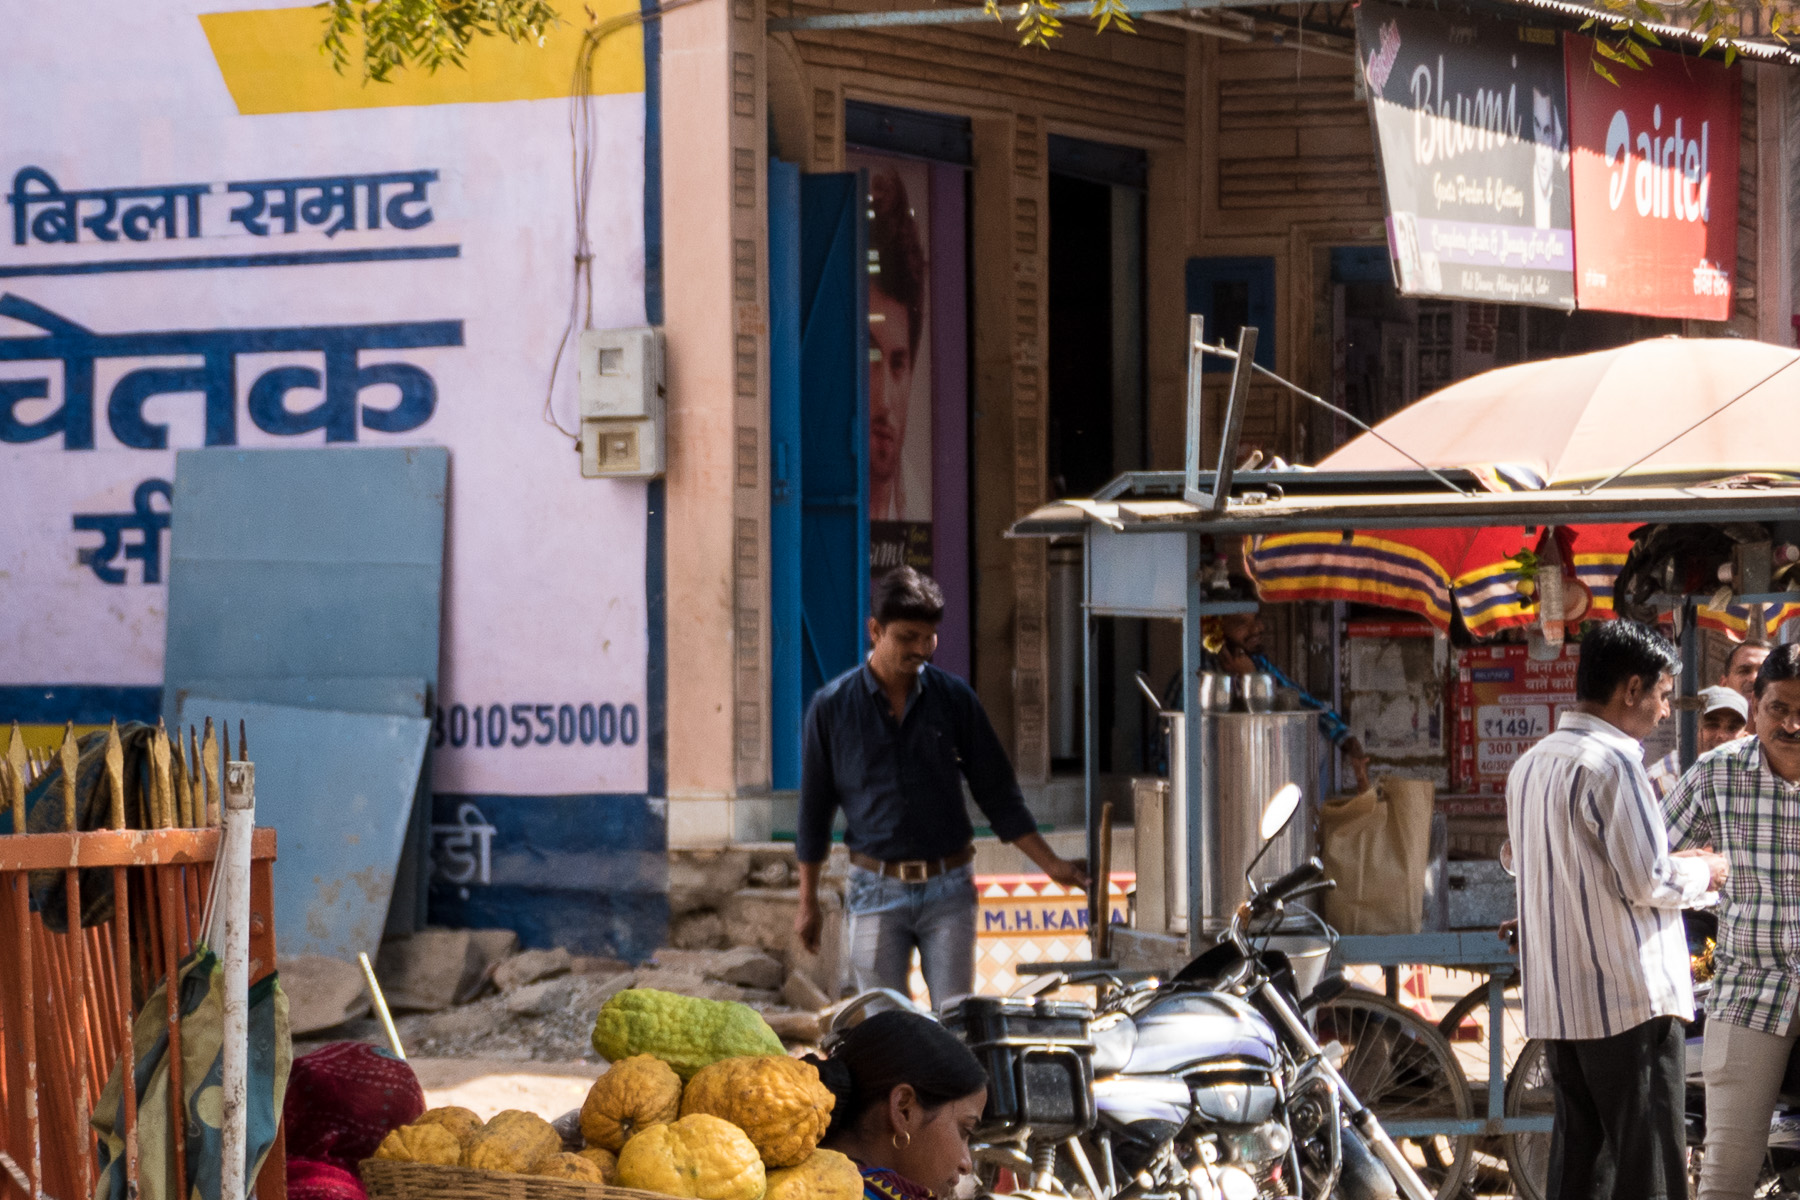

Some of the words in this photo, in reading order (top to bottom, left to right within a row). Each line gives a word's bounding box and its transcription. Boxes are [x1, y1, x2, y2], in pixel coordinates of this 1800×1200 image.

[1410, 55, 1522, 166] Bhumi
[1634, 103, 1710, 222] airtel
[7, 167, 208, 246] बिरला
[227, 169, 440, 240] सम्राट
[1488, 743, 1513, 756] 300
[984, 907, 1125, 932] M.H.KARA
